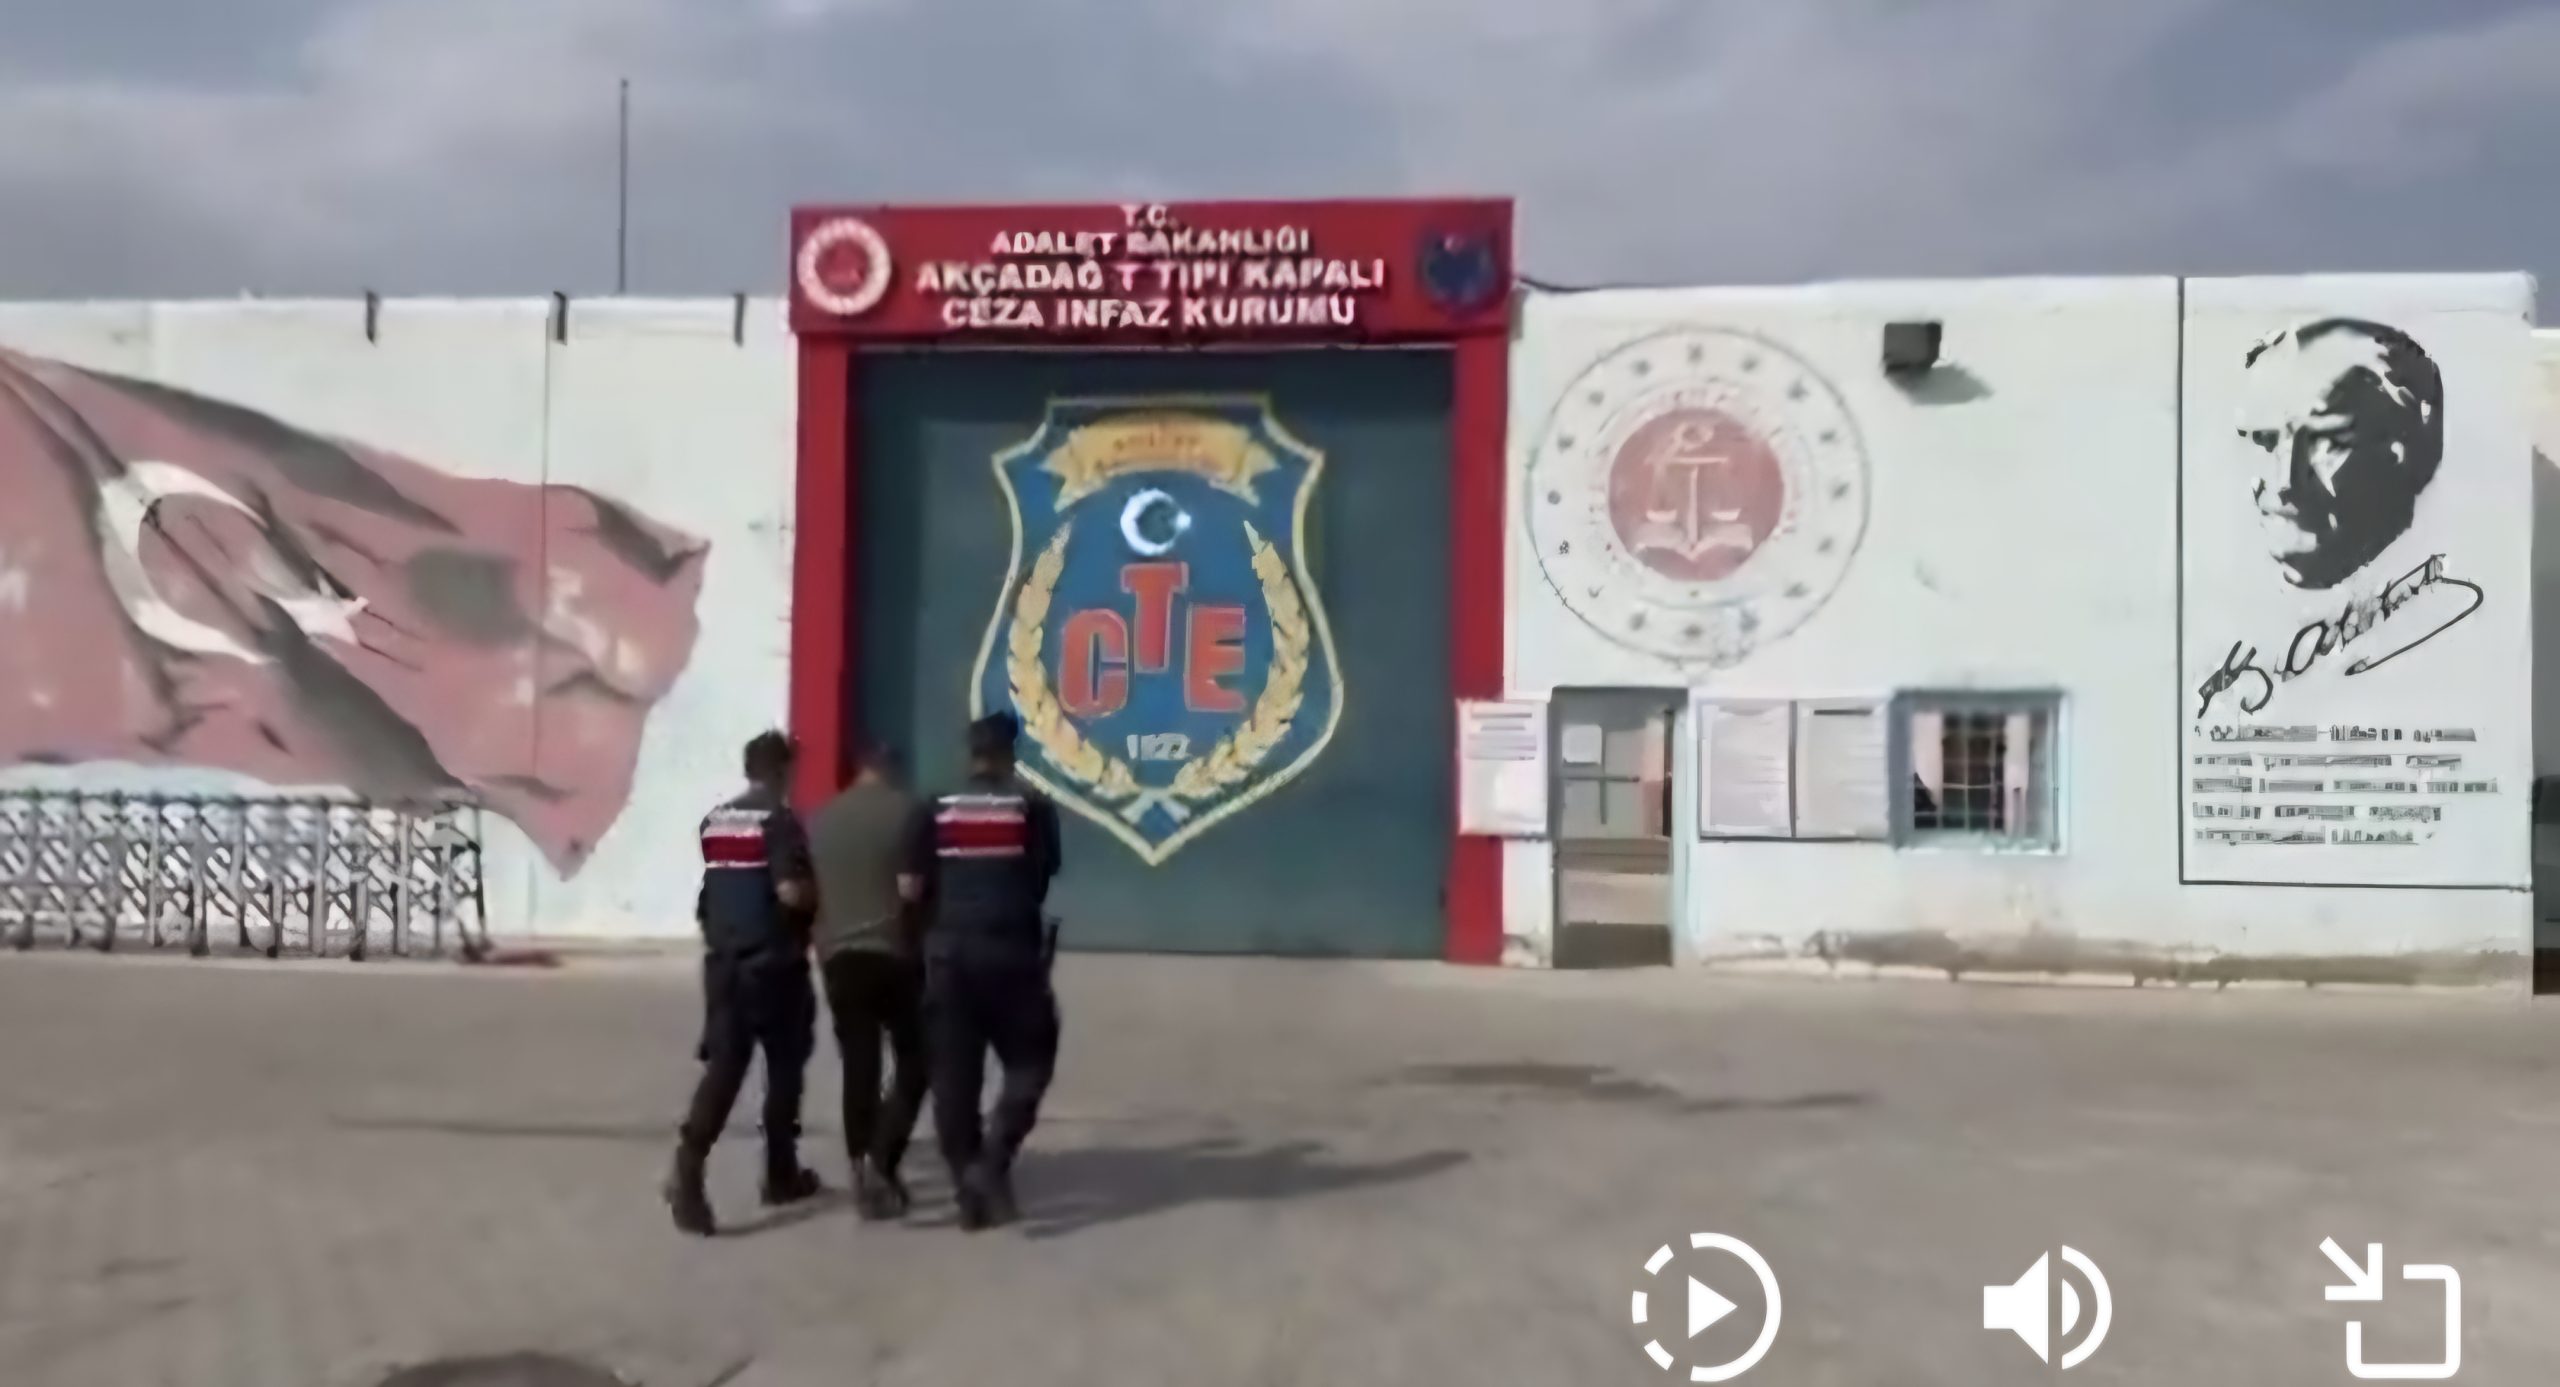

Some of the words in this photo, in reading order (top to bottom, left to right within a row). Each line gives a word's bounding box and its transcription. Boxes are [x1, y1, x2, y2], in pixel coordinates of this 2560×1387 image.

[990, 230, 1119, 256] ADALET
[1113, 262, 1144, 292] T
[1242, 256, 1386, 291] KAPALI
[941, 296, 1046, 330] CEZA
[1181, 293, 1357, 327] KURUMU
